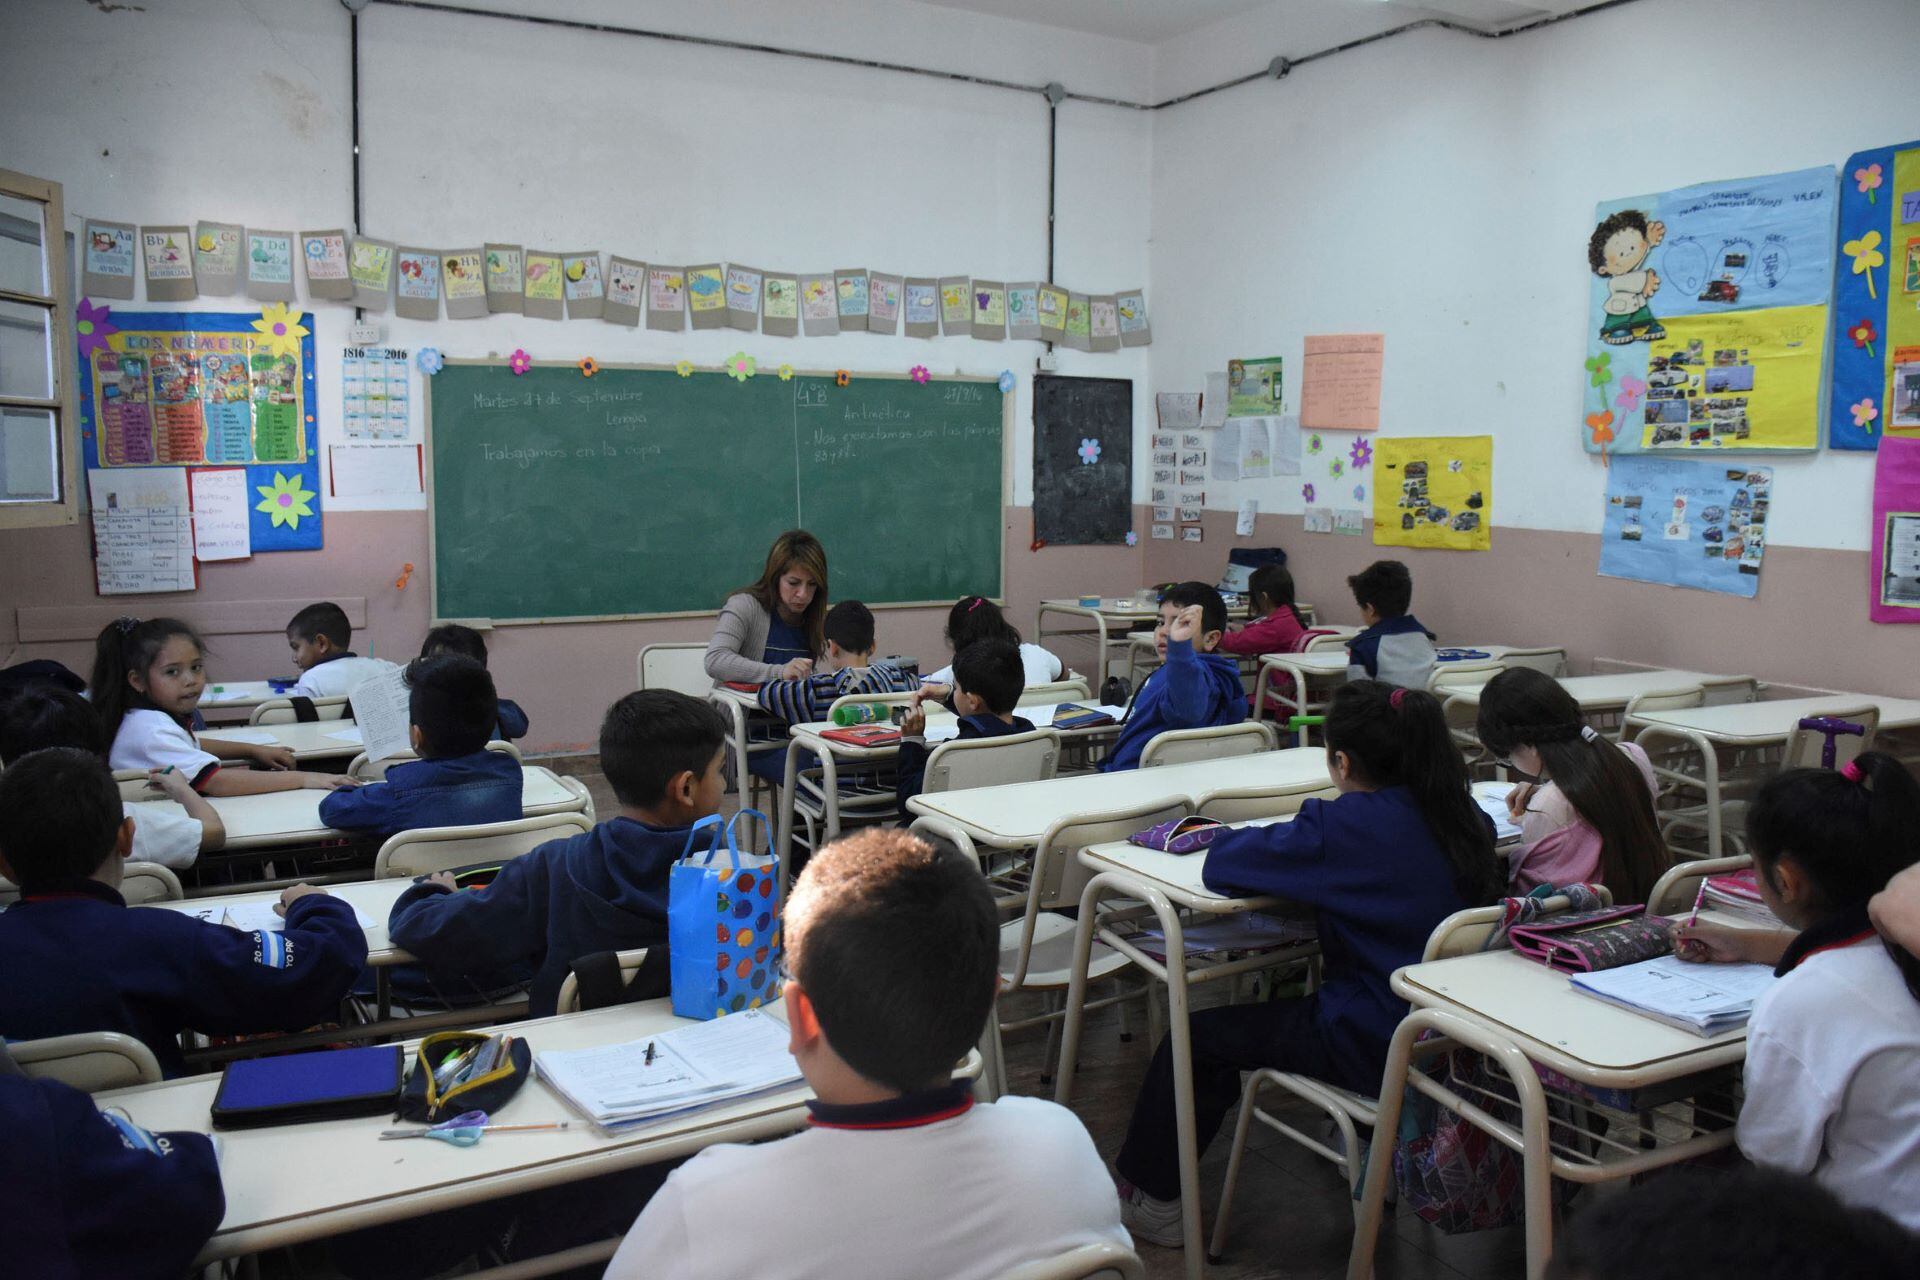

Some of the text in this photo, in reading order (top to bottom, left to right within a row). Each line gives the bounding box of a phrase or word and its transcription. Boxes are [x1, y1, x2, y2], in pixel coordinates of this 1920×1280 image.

[114, 229, 132, 241] Aa
[146, 235, 164, 246] Bb
[267, 240, 286, 251] Dd
[324, 238, 342, 248] Ee
[126, 336, 162, 350] LOS
[343, 347, 365, 359] 1816
[384, 348, 408, 360] 2016
[473, 392, 518, 409] Martes
[523, 391, 542, 407] 27
[546, 390, 562, 405] de
[606, 411, 647, 431] Lengua
[814, 427, 836, 446] Nos
[917, 428, 938, 439] con
[943, 420, 961, 437] las
[479, 440, 661, 469] Trabajamos en la copia
[253, 950, 262, 963] 20
[285, 954, 294, 968] YO
